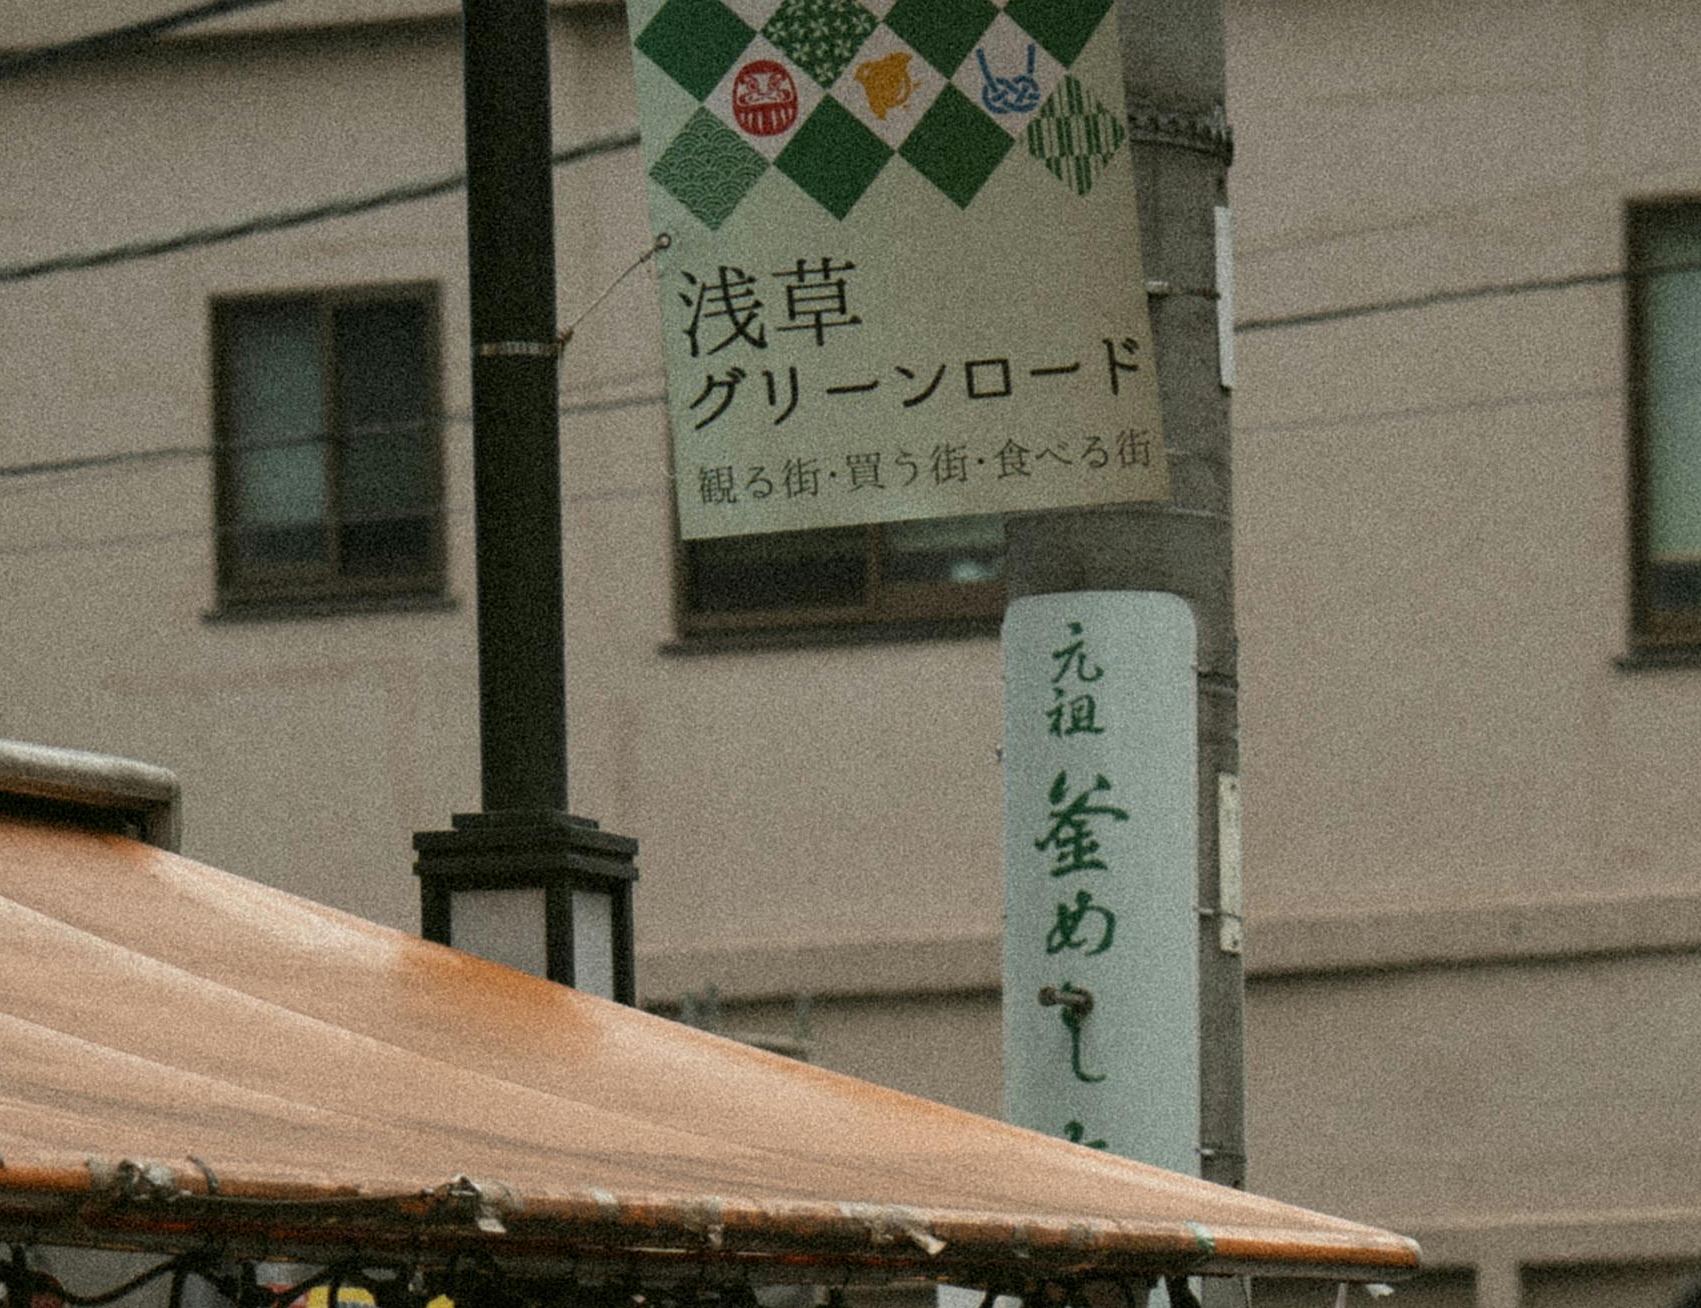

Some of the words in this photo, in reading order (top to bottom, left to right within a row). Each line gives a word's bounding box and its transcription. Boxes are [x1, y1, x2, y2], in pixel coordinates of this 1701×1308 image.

[677, 257, 863, 359] 浅草
[688, 335, 1141, 430] グリーンロード
